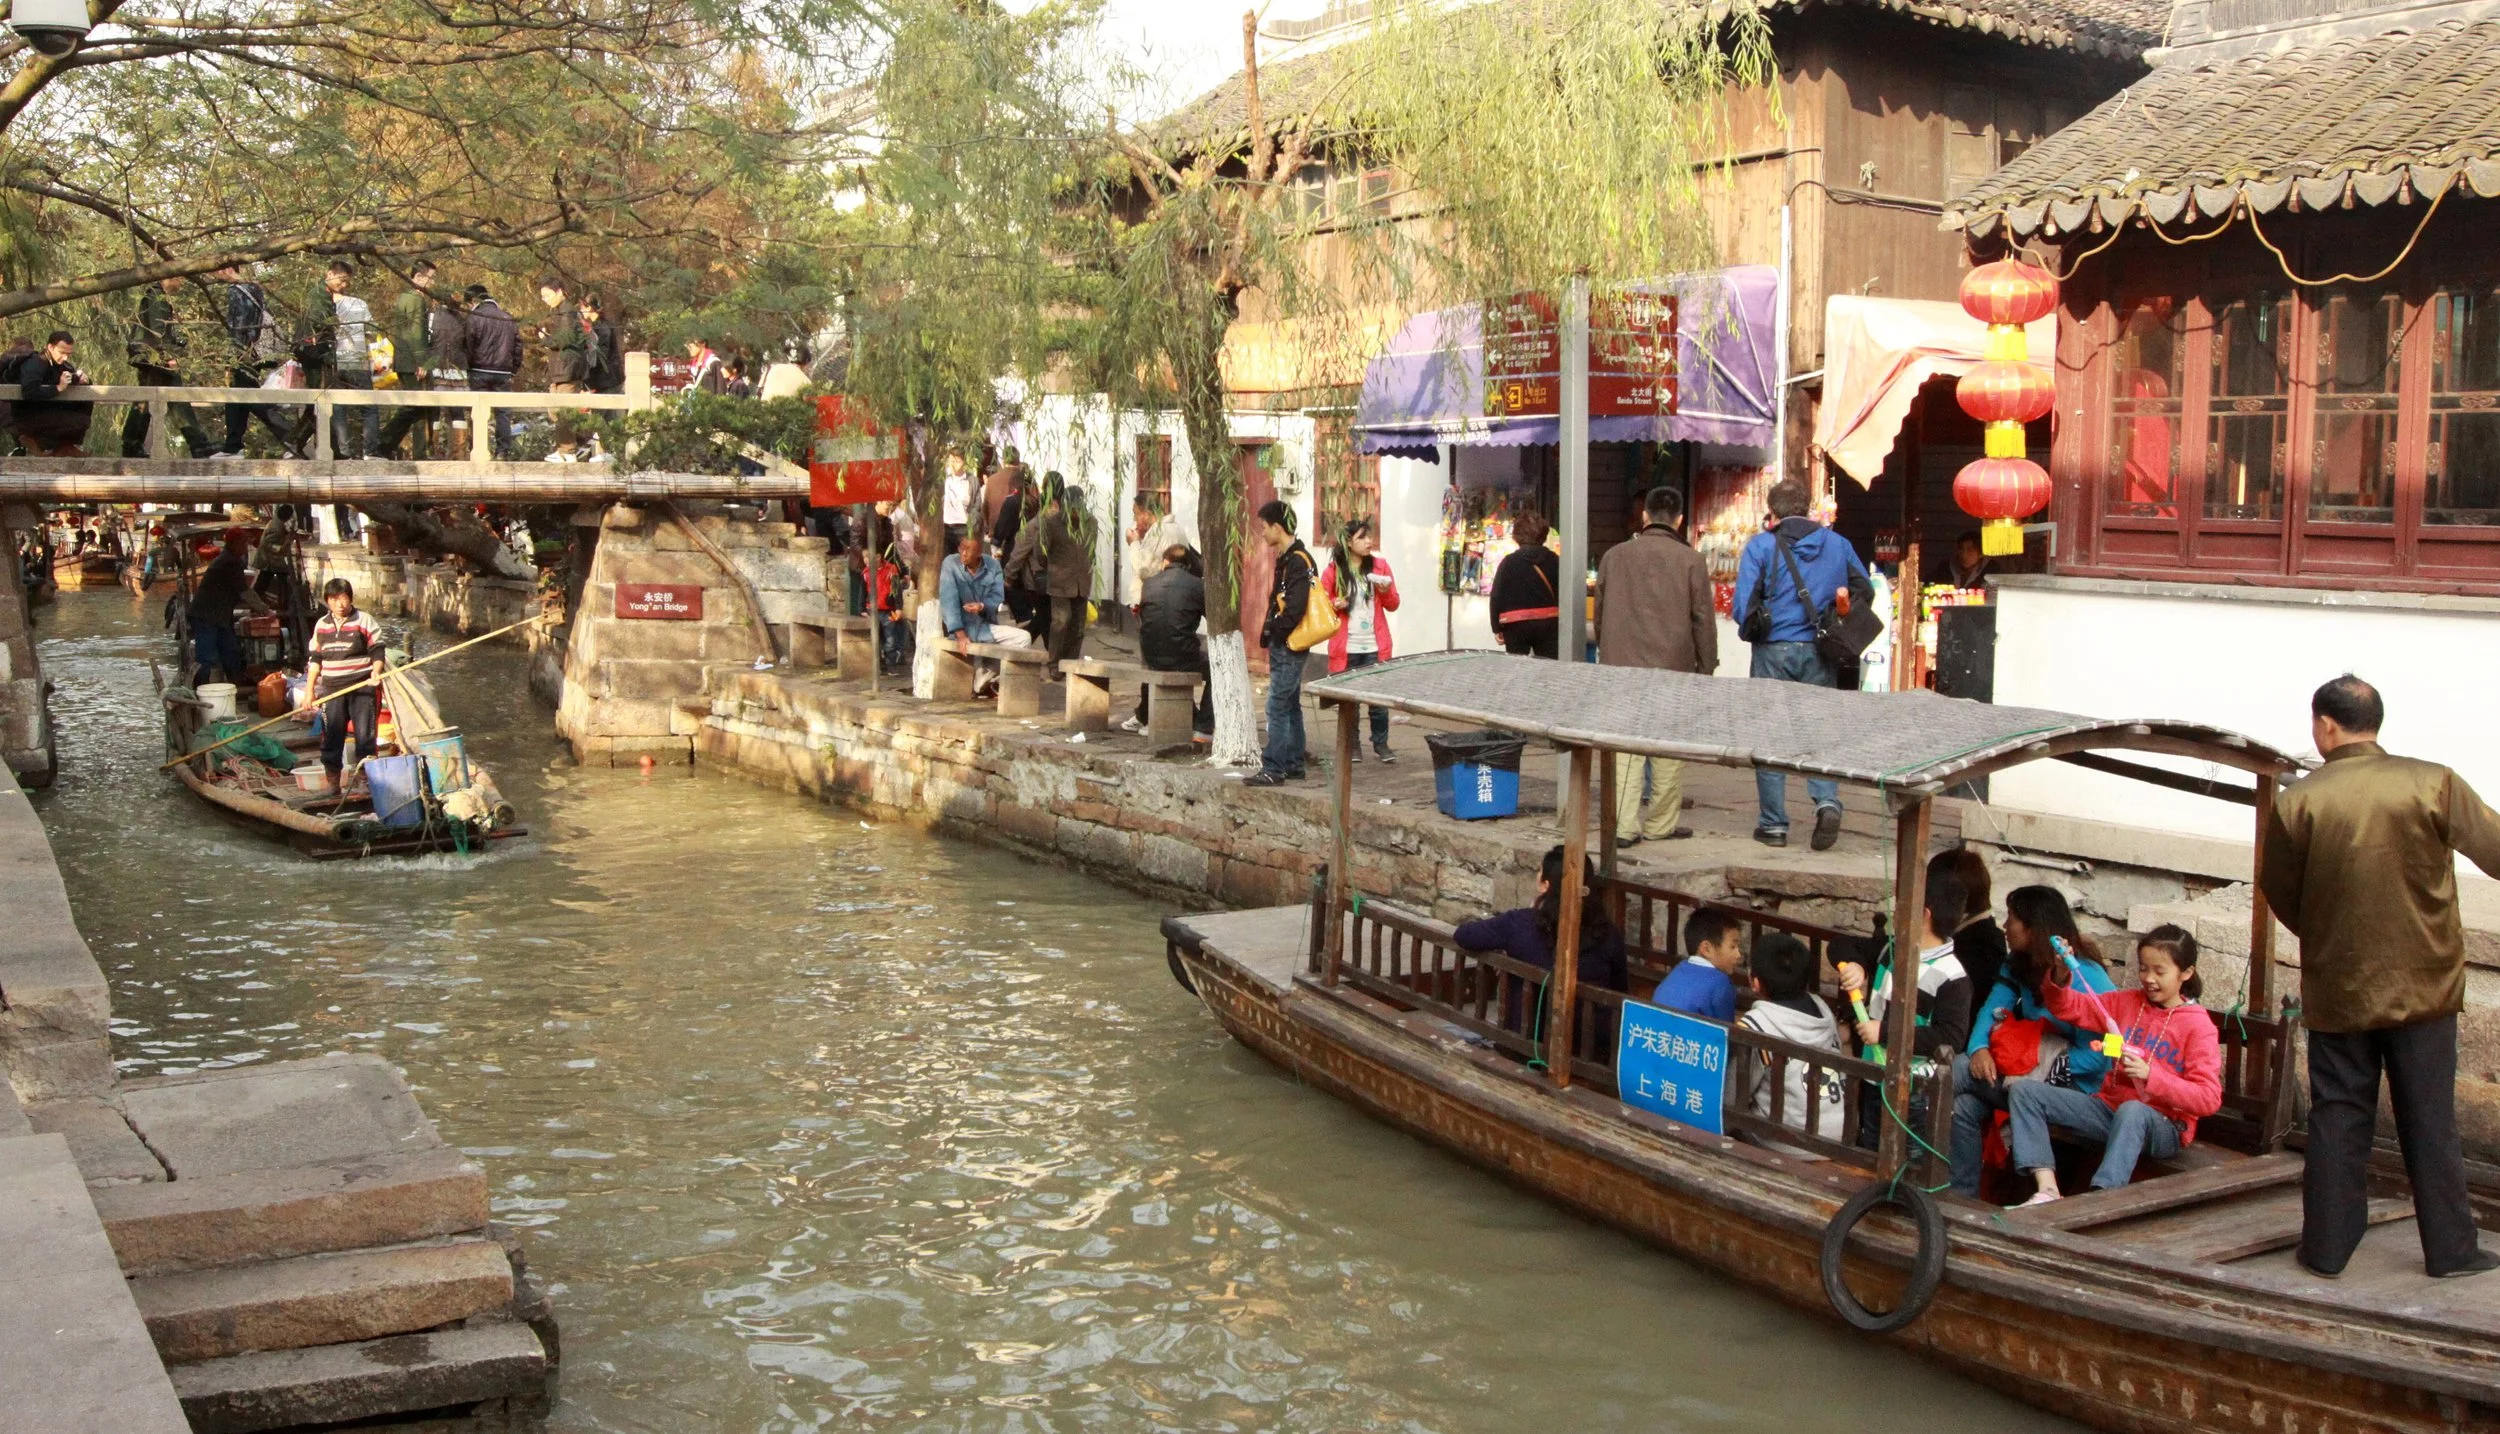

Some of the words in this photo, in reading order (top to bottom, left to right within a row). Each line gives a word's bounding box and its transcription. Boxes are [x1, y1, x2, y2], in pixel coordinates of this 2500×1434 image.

[1631, 387, 1653, 397] 北大街
[644, 592, 673, 602] 永安桥
[664, 603, 688, 612] Bridge
[1628, 1022, 1701, 1067] 沪朱家角游
[1703, 1044, 1719, 1072] 63
[1636, 1073, 1703, 1115] 上海港
